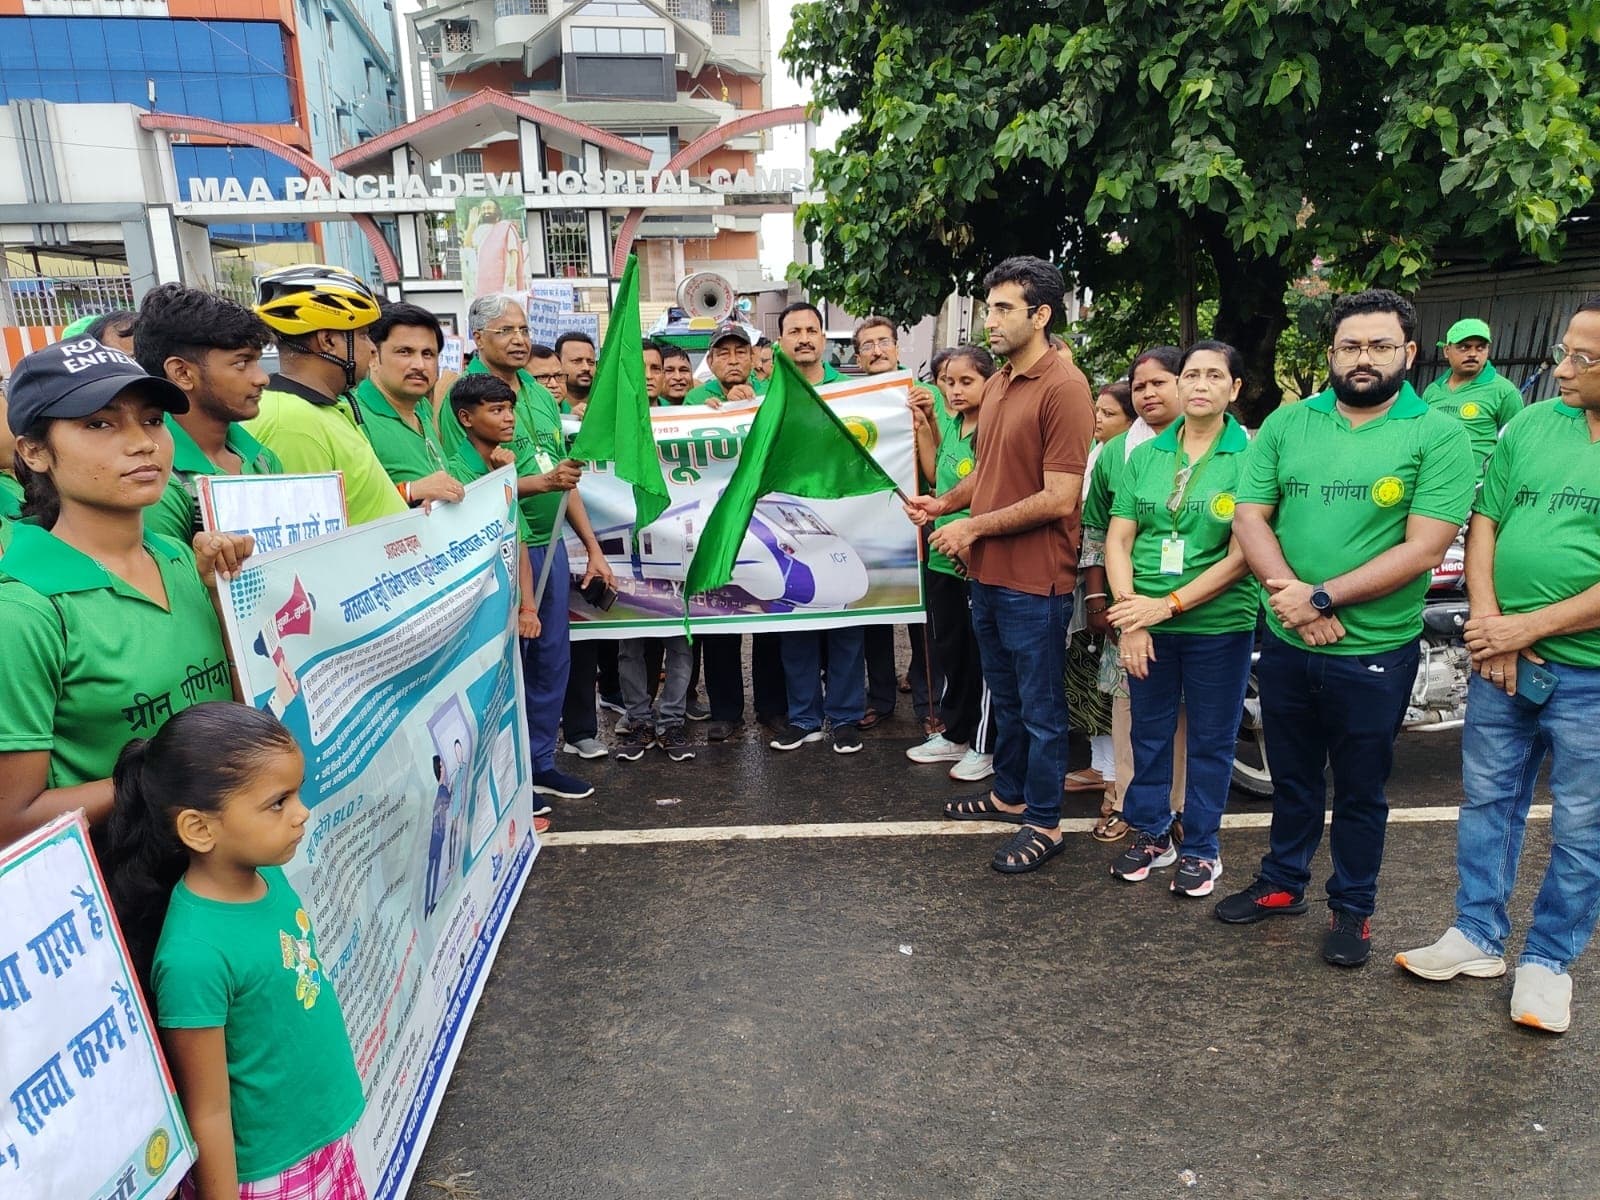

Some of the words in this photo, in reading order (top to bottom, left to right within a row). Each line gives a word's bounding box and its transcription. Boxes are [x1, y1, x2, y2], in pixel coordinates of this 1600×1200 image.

[188, 177, 274, 201] MAA
[285, 174, 430, 201] PANCHA
[440, 172, 524, 197] DEVI
[533, 169, 701, 195] HOSPITAL
[1286, 476, 1310, 498] ग्रीन
[1320, 479, 1368, 508] पूर्णिया
[1548, 486, 1600, 515] पूर्णिया
[1441, 562, 1464, 572] Hero
[339, 590, 378, 623] मतदाता
[370, 577, 392, 612] सूची
[121, 692, 173, 731] ग्रीन
[180, 657, 230, 706] पर्णिया
[333, 801, 354, 827] BLO
[26, 909, 86, 979] गरम
[70, 885, 104, 940] है
[10, 1051, 76, 1136] सच्चा
[67, 1004, 127, 1079] करम
[111, 980, 139, 1035] है
